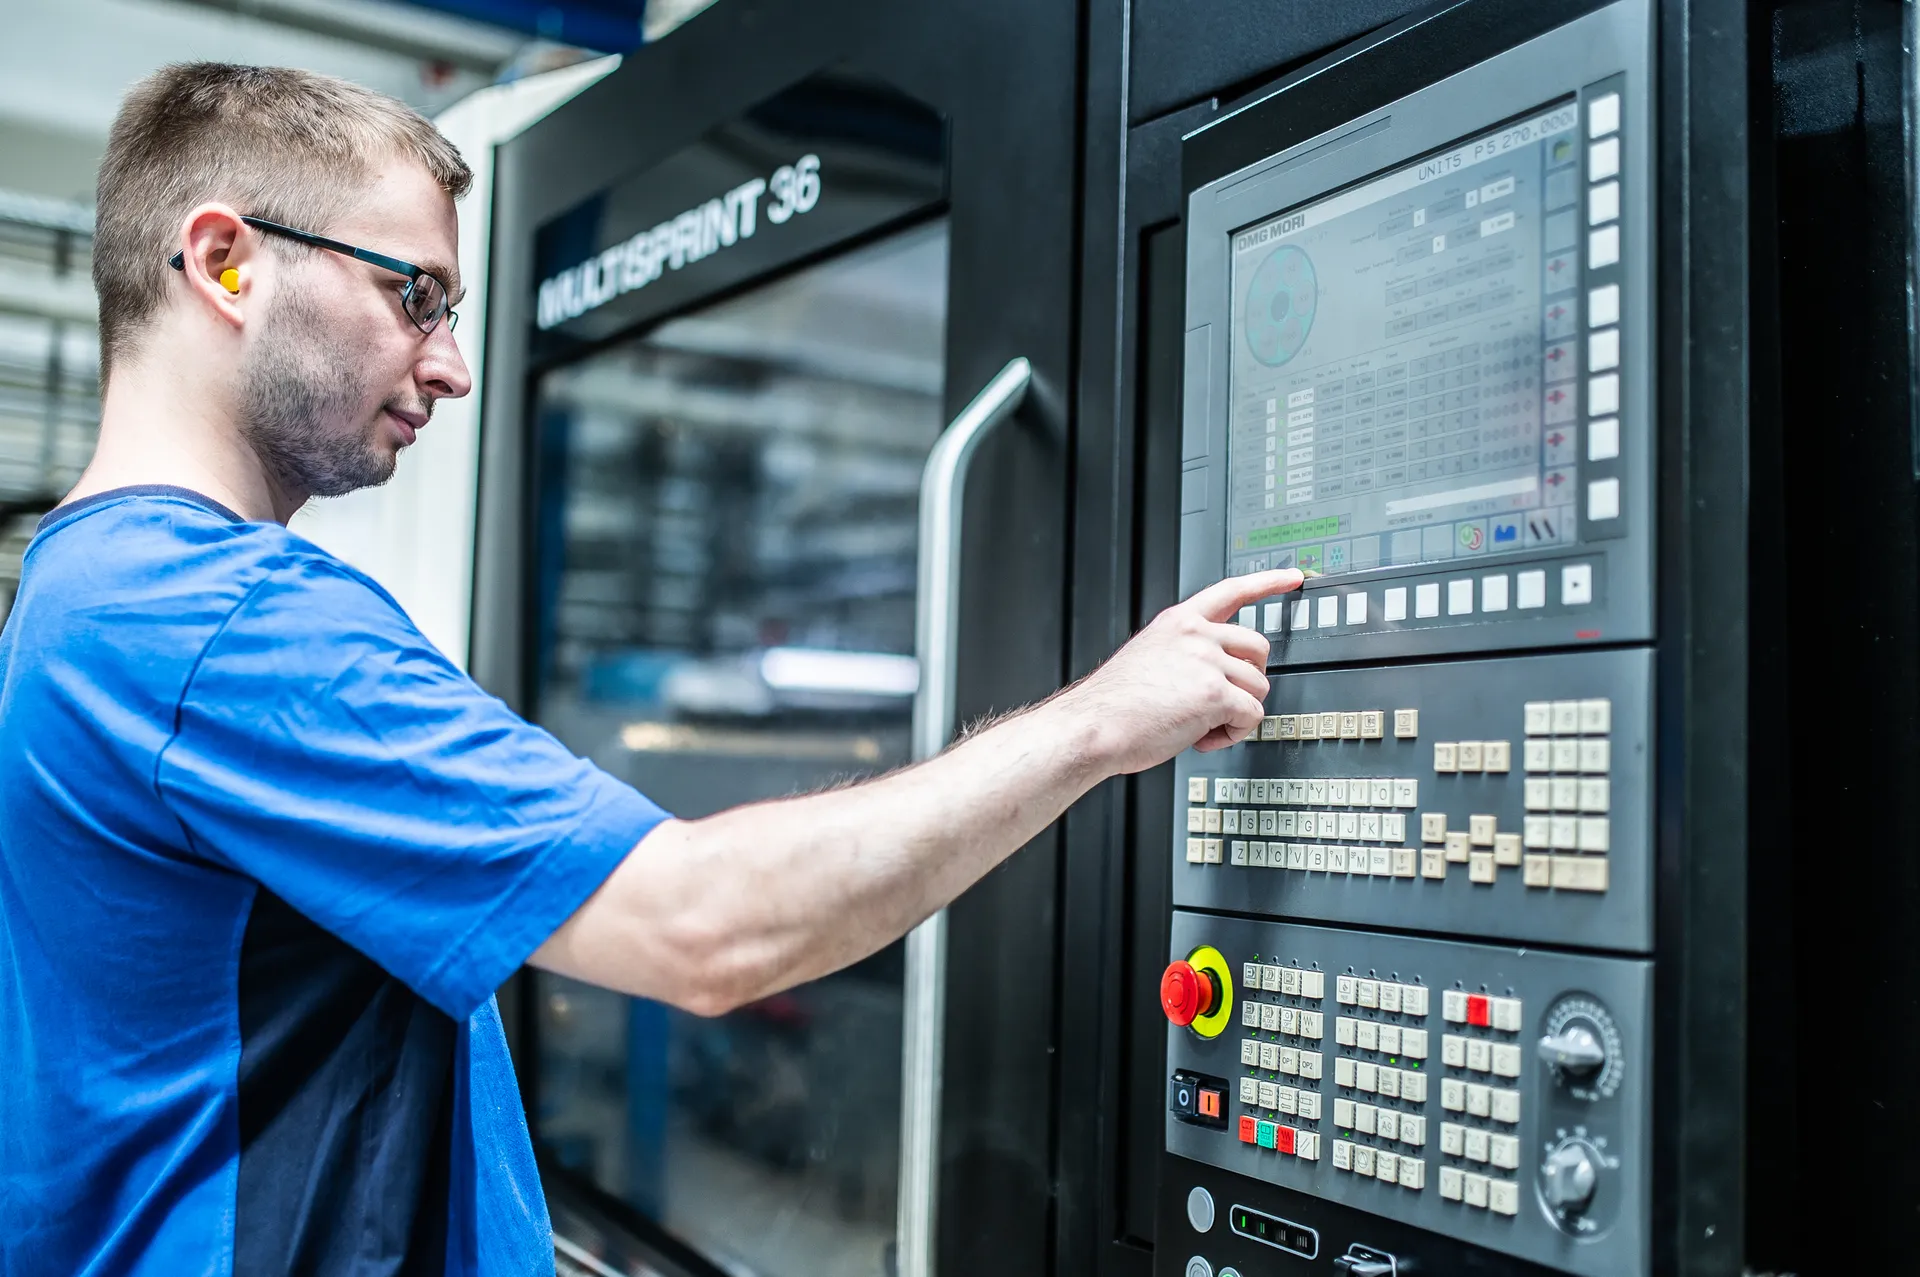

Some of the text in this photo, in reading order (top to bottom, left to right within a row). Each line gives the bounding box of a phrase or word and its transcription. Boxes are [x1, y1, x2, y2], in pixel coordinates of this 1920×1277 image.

[1418, 153, 1462, 181] UNIT5
[536, 152, 822, 331] MULTISPRINT 36
[1237, 213, 1306, 252] DMG MORI
[1221, 785, 1228, 798] Q
[1238, 786, 1246, 798] W
[1257, 786, 1263, 798] E
[1276, 786, 1283, 798] R
[1296, 786, 1303, 799] T
[1315, 786, 1322, 799] Y
[1336, 787, 1343, 800] U
[1379, 788, 1387, 801] O
[1229, 817, 1236, 829] A
[1247, 818, 1254, 830] S
[1266, 818, 1273, 830] D
[1285, 819, 1292, 830] F
[1305, 820, 1312, 832] G
[1325, 820, 1333, 833] H
[1346, 821, 1354, 833] J
[1369, 822, 1375, 835] K
[1391, 823, 1398, 836] L
[1237, 848, 1244, 860] Z
[1255, 848, 1262, 861] X
[1274, 850, 1281, 863] C
[1294, 852, 1302, 864] V
[1315, 853, 1322, 866] B
[1335, 854, 1342, 867] N
[1357, 856, 1365, 869] M
[1281, 1056, 1293, 1065] OP1
[1301, 1060, 1313, 1070] OP2
